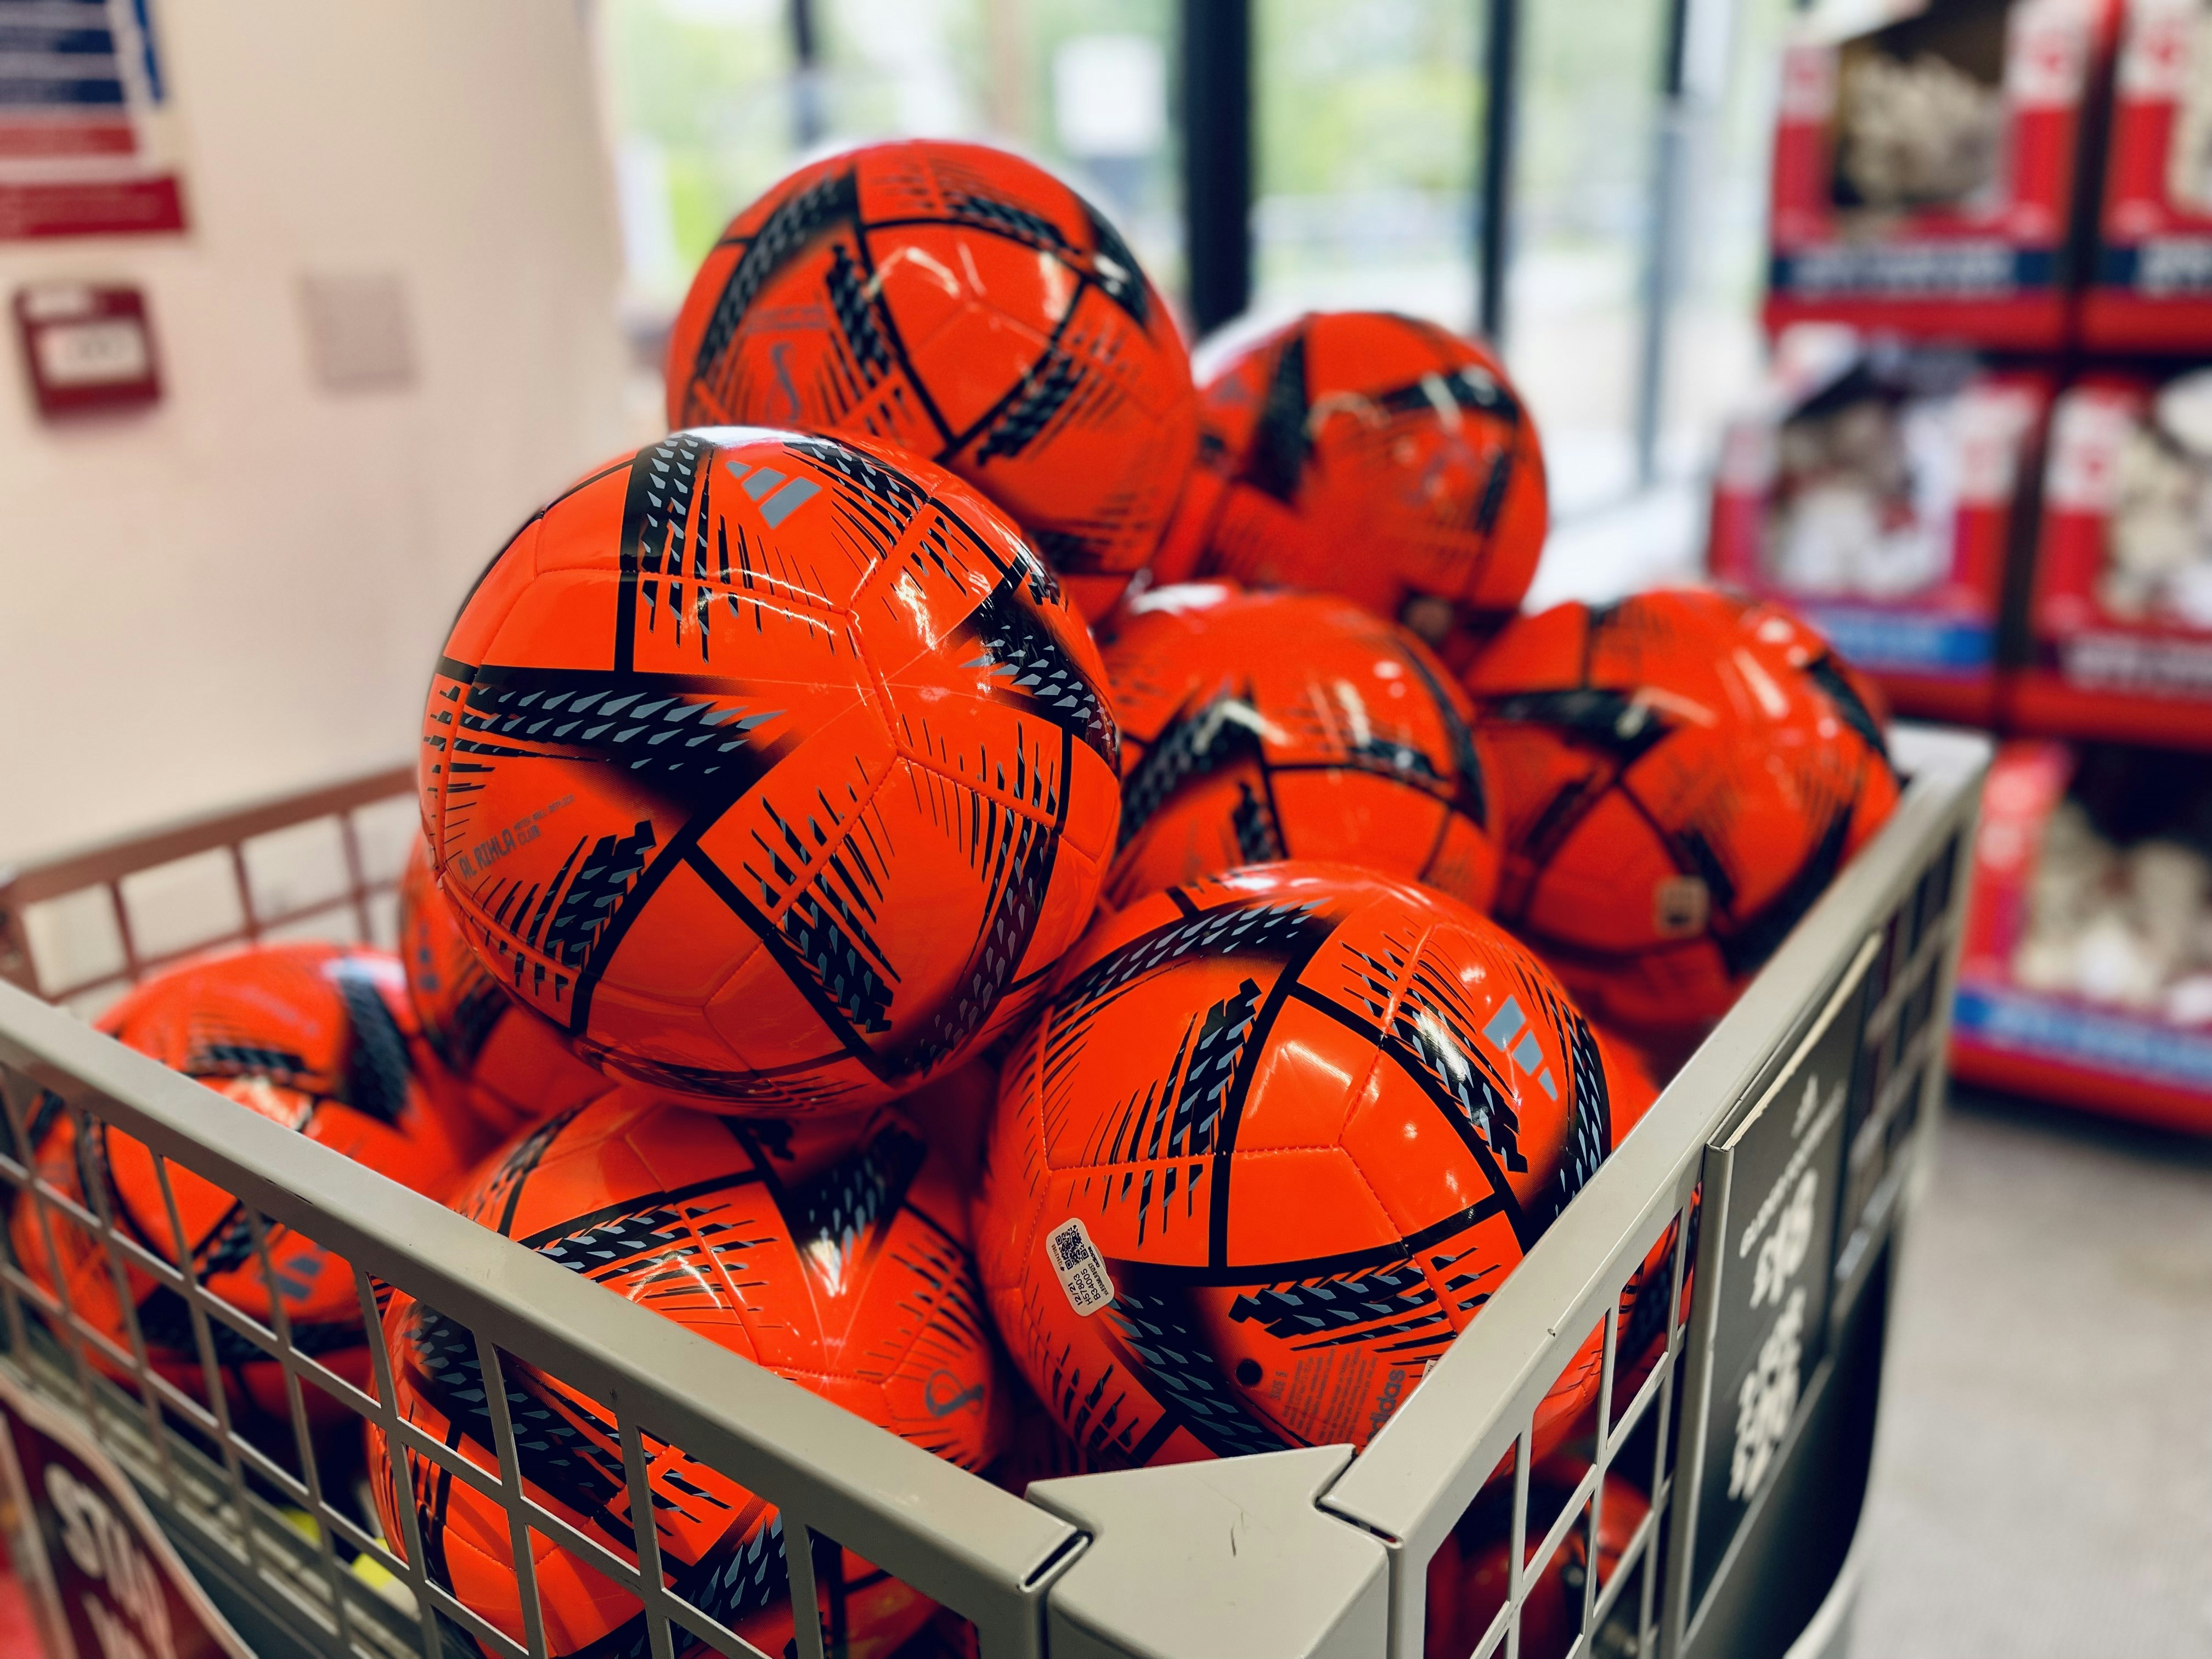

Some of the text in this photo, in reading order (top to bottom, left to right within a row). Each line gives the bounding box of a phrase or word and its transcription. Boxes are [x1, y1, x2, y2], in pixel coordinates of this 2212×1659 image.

[473, 828, 517, 871] RIHLA
[1088, 1246, 1100, 1268] adidas
[1068, 1283, 1083, 1306] 12/21
[1074, 1273, 1093, 1306] H57803
[1081, 1268, 1101, 1300] B34005
